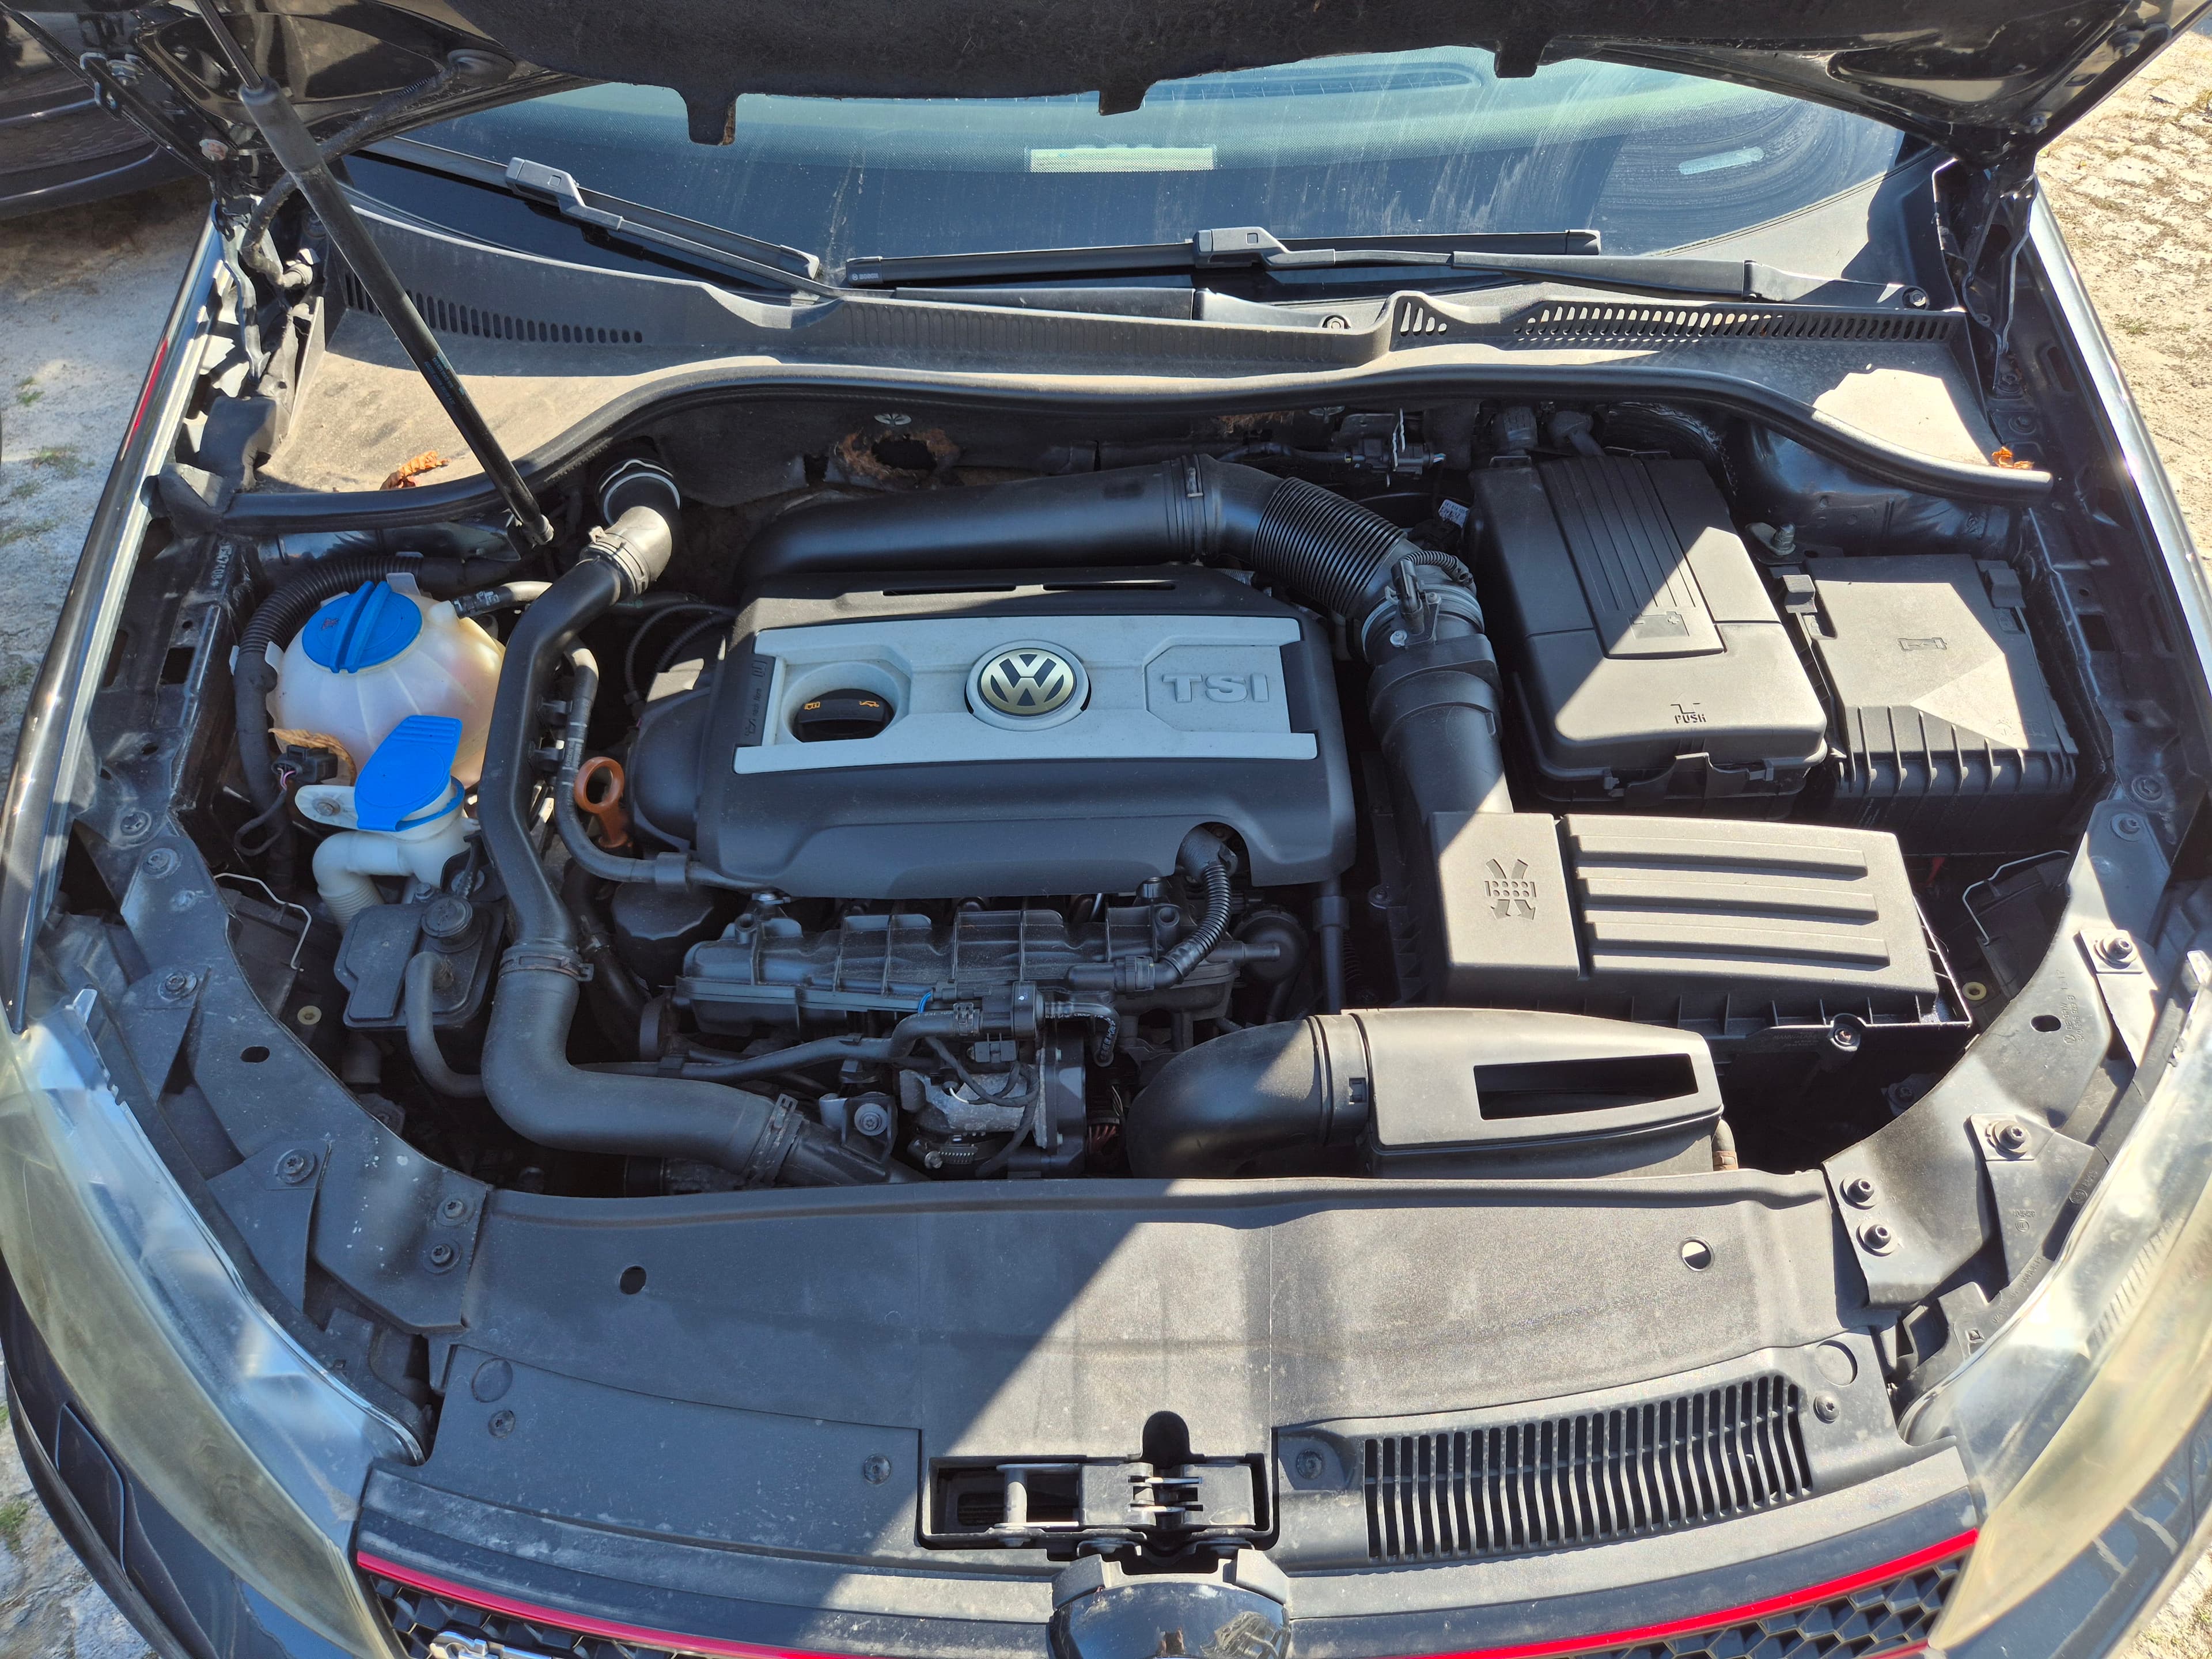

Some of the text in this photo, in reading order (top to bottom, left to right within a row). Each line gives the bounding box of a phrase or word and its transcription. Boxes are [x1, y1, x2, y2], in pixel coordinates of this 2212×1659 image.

[978, 647, 1077, 717] VW
[1161, 673, 1270, 703] TSI
[1674, 713, 1706, 724] PUSH
